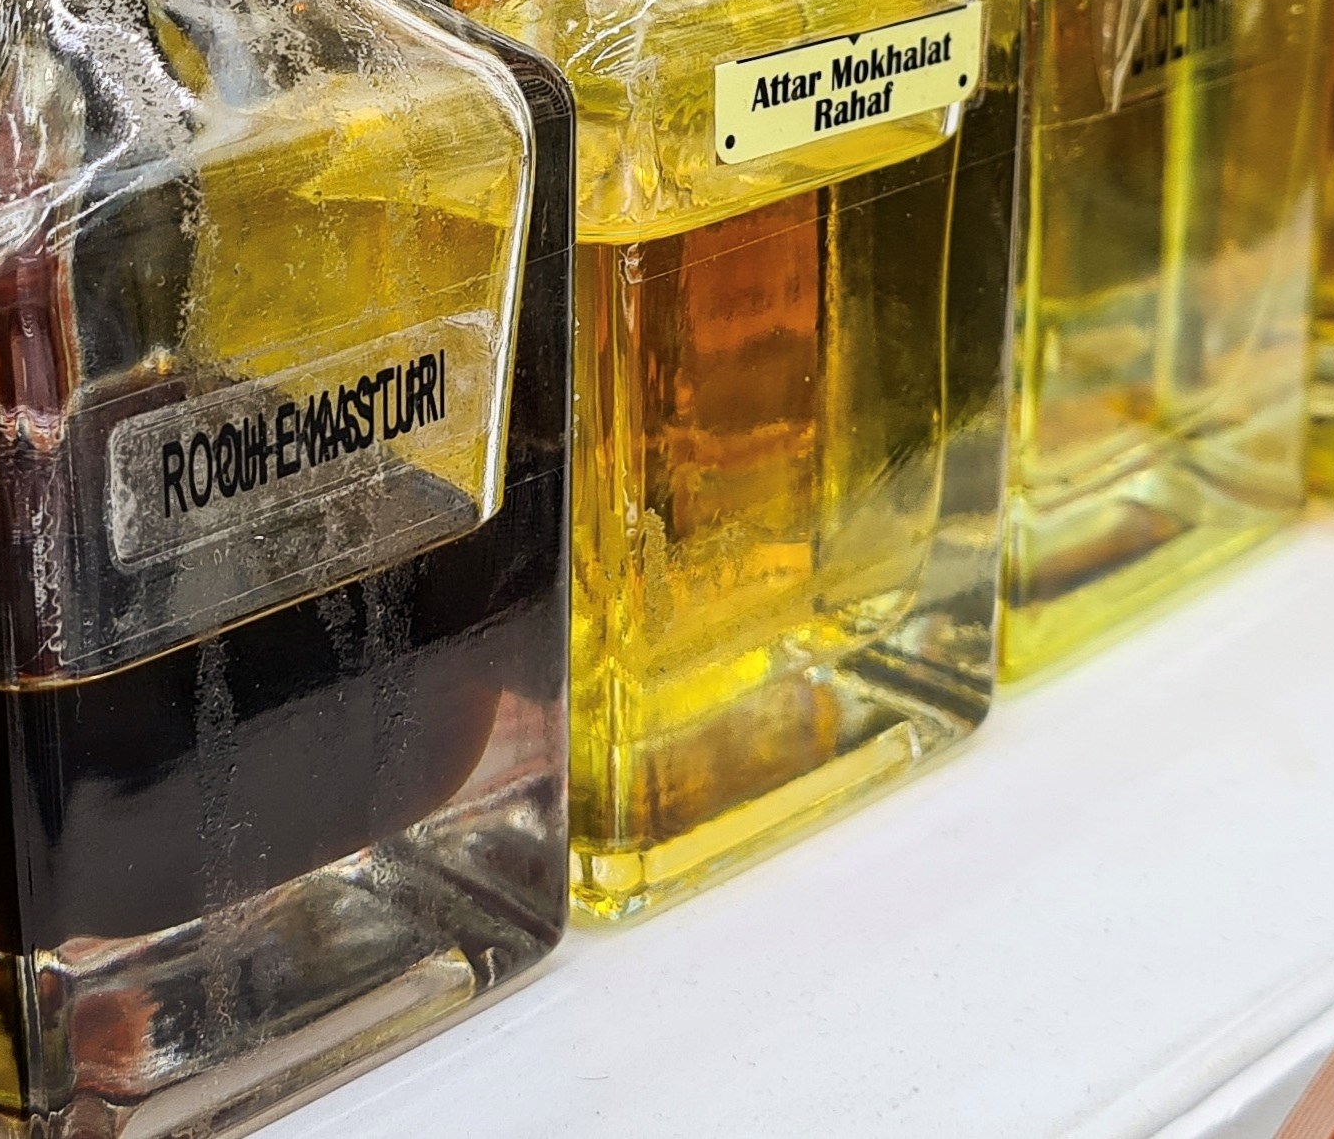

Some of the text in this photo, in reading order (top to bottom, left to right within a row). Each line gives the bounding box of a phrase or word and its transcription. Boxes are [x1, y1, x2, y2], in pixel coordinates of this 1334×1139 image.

[751, 31, 951, 112] Attar Mokhalat
[814, 80, 894, 132] Rahaf
